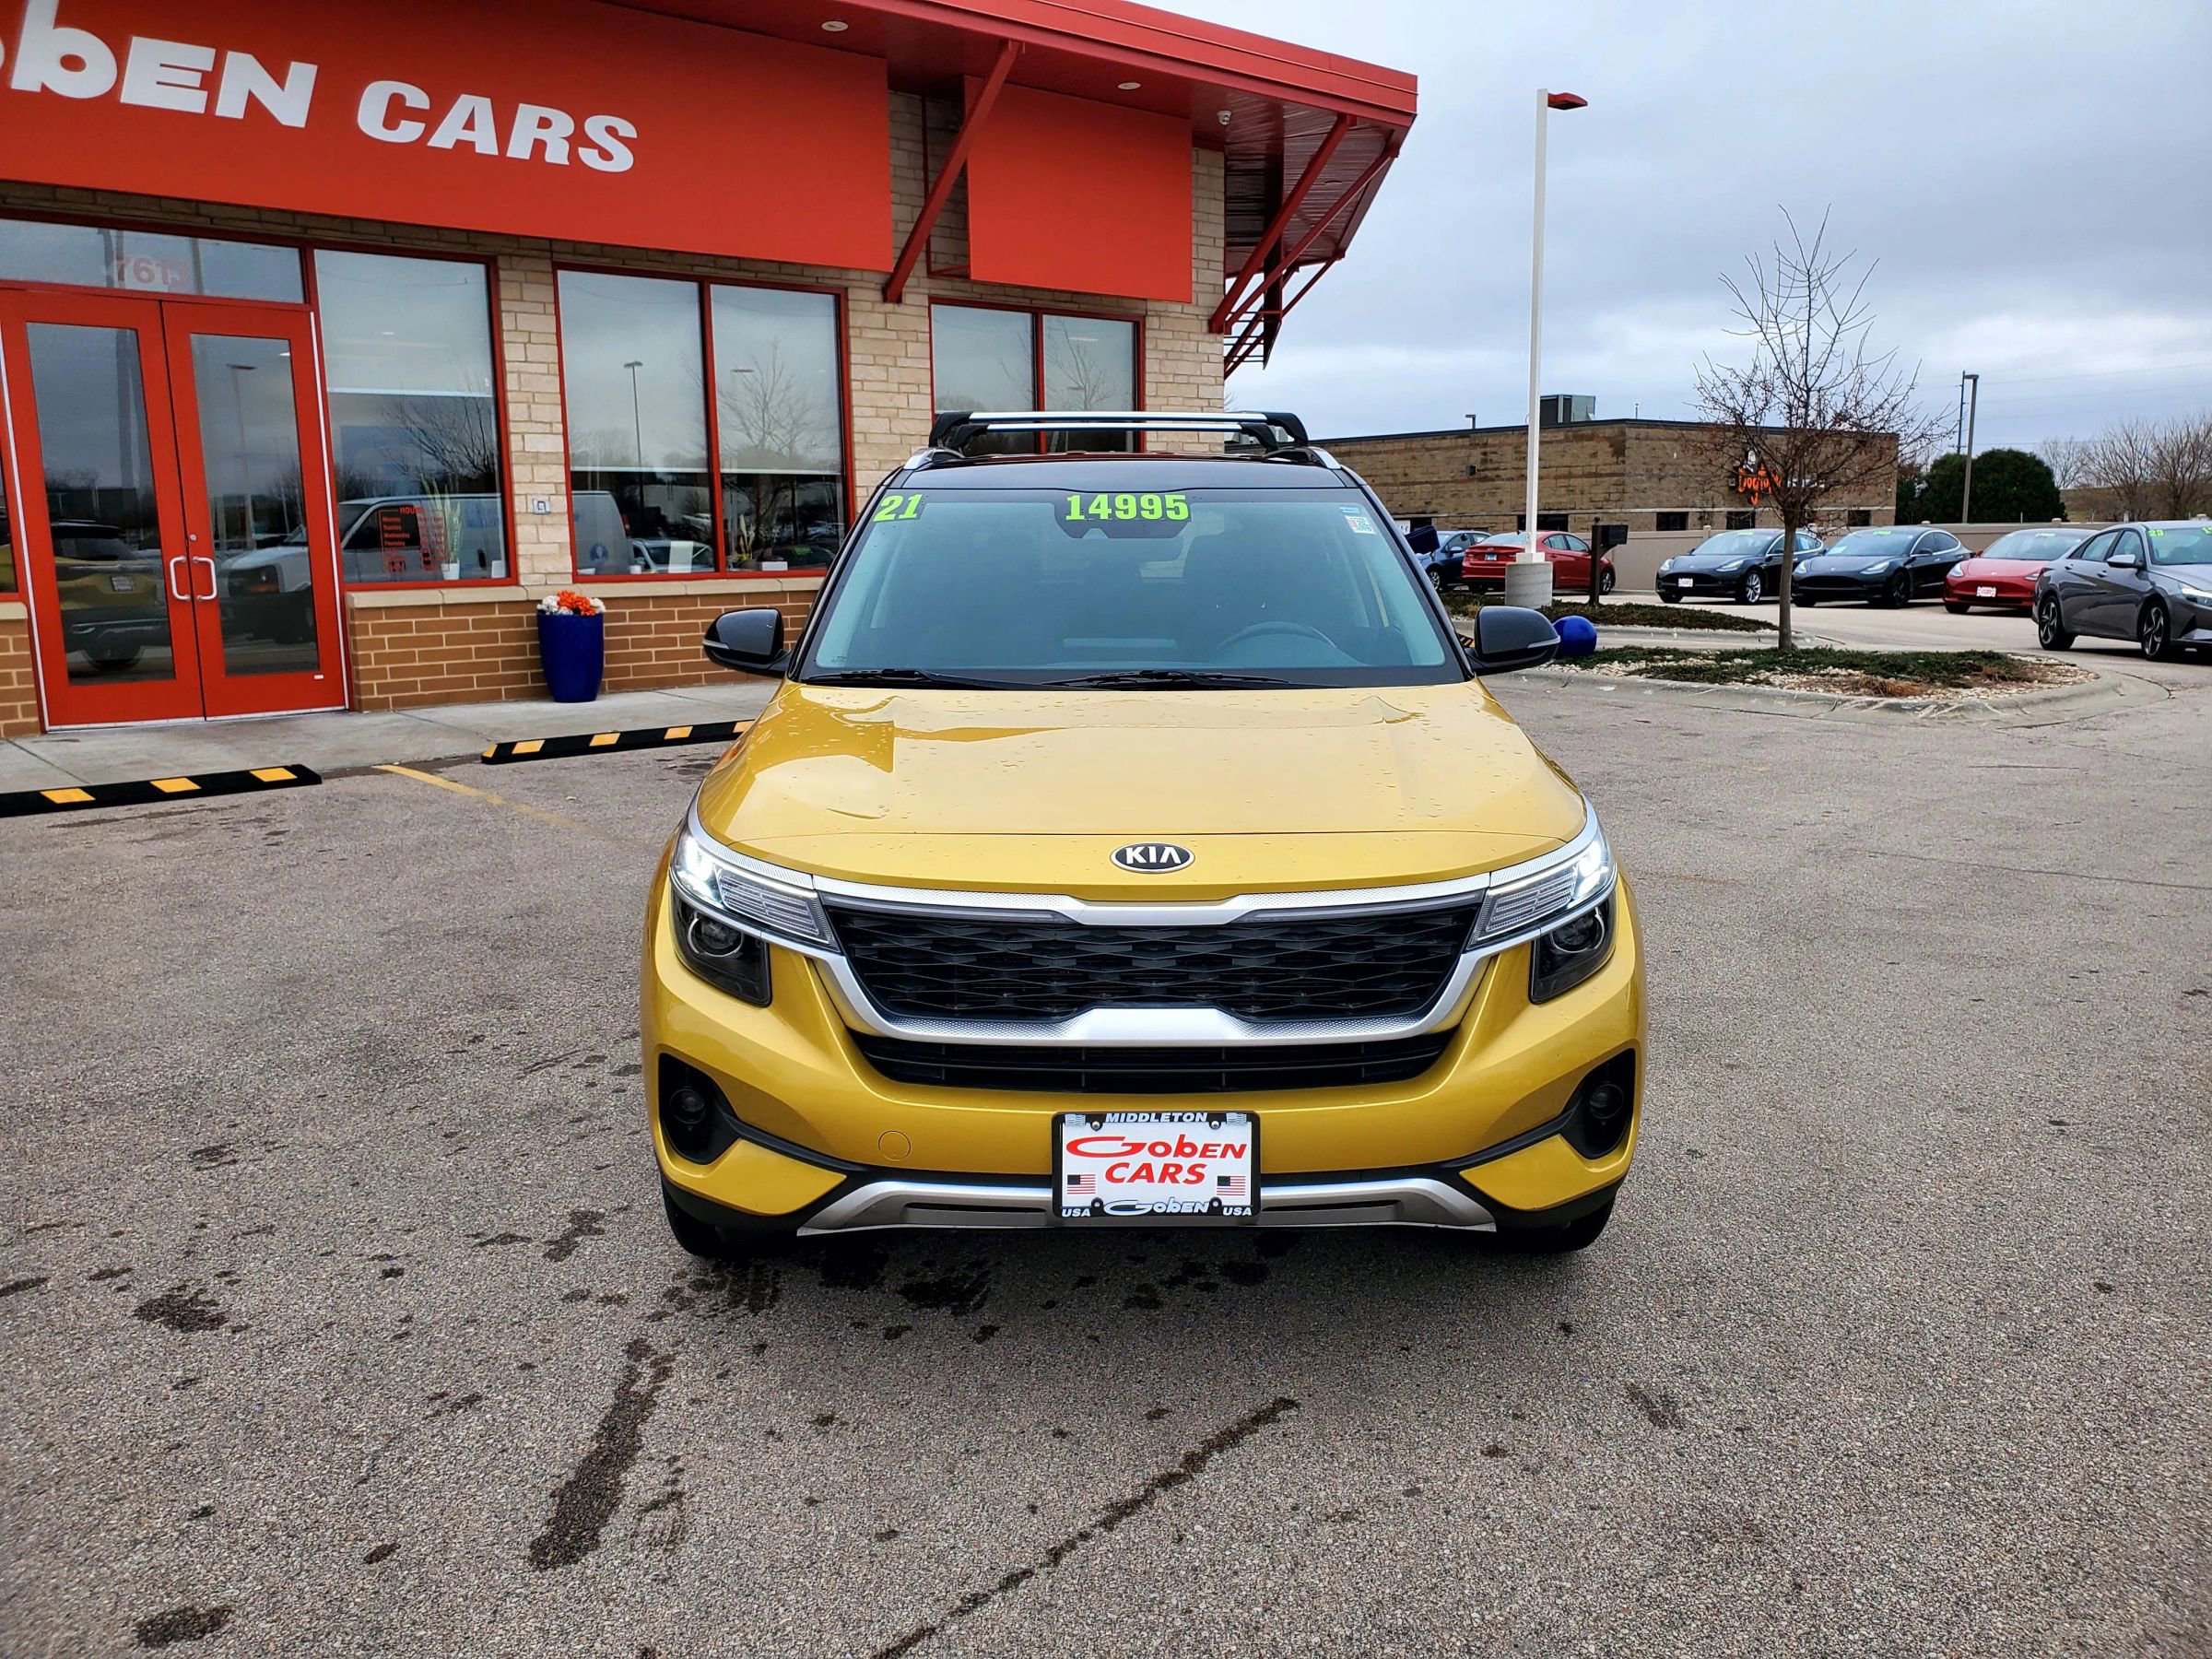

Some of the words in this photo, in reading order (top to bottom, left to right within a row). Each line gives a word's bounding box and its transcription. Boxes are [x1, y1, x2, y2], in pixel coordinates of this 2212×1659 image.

[0, 0, 317, 128] bEN
[358, 80, 638, 173] CARS
[873, 493, 923, 522] 21
[1065, 493, 1190, 522] 14995
[1125, 846, 1182, 865] KIA
[1105, 1112, 1208, 1123] MIDDLETON
[1104, 1162, 1208, 1184] CARS
[1061, 1207, 1091, 1218] USA
[1222, 1206, 1253, 1217] USA
